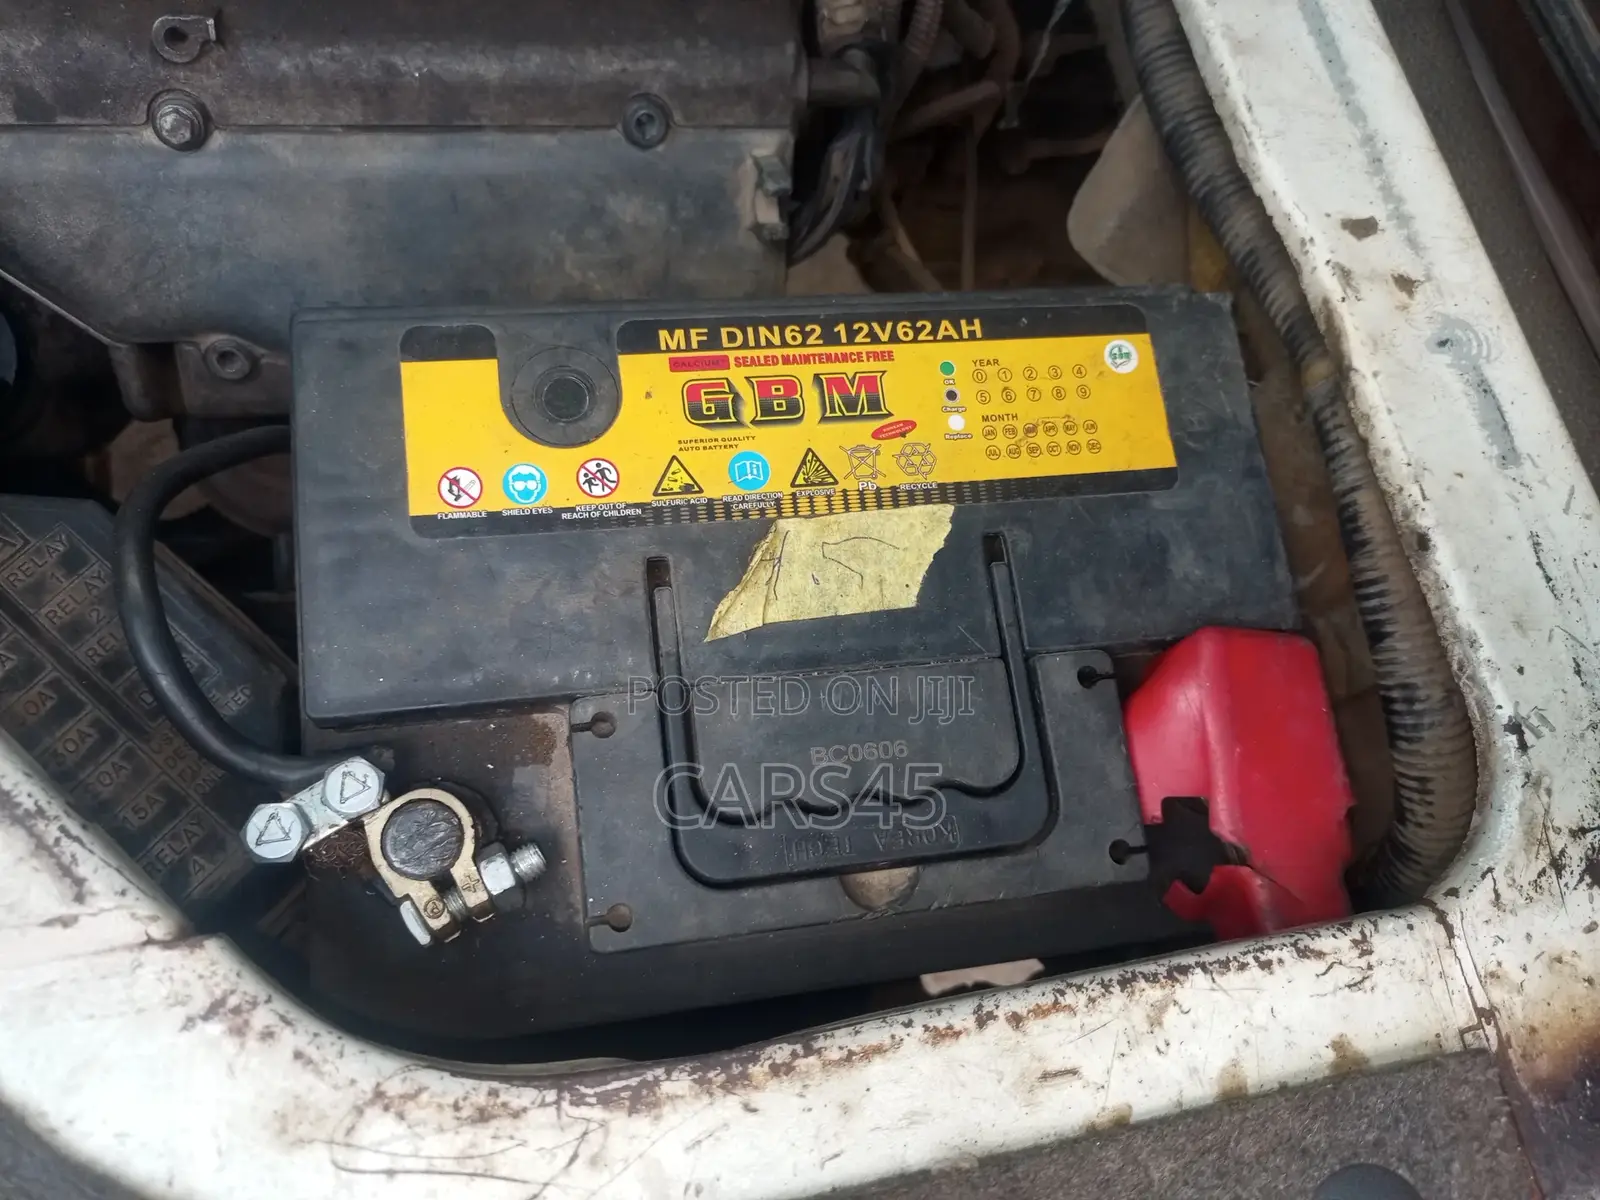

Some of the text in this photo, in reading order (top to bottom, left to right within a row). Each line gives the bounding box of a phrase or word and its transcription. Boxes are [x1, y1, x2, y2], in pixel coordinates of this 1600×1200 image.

[658, 318, 983, 350] MF DIN62 12V62AH
[734, 350, 895, 368] SEALED MAINTENANCE FREE
[972, 358, 1000, 368] YEAR
[682, 371, 893, 429] GBM
[942, 405, 967, 413] Charge
[982, 413, 1018, 423] MONTH
[678, 435, 756, 445] SUPERIOR QUALITY
[678, 443, 739, 453] AUTO BATTERY
[858, 481, 877, 492] Pb
[900, 482, 938, 491] RECYCLE
[722, 491, 784, 503] READ DIRECTION
[796, 488, 836, 497] EXPLOSIVE
[575, 502, 627, 513] KEEP OUT OF
[651, 496, 708, 508] SULFURIC ACID
[732, 501, 776, 511] CAREFULLY
[437, 510, 488, 520] FLAMMABLE
[502, 506, 553, 517] SHIELD EYES
[561, 508, 642, 520] REACH OF CHILDREN
[7, 533, 68, 589] RELAY
[44, 569, 109, 625] RELAY
[810, 740, 909, 766] BC0606
[142, 819, 208, 876] RELAY
